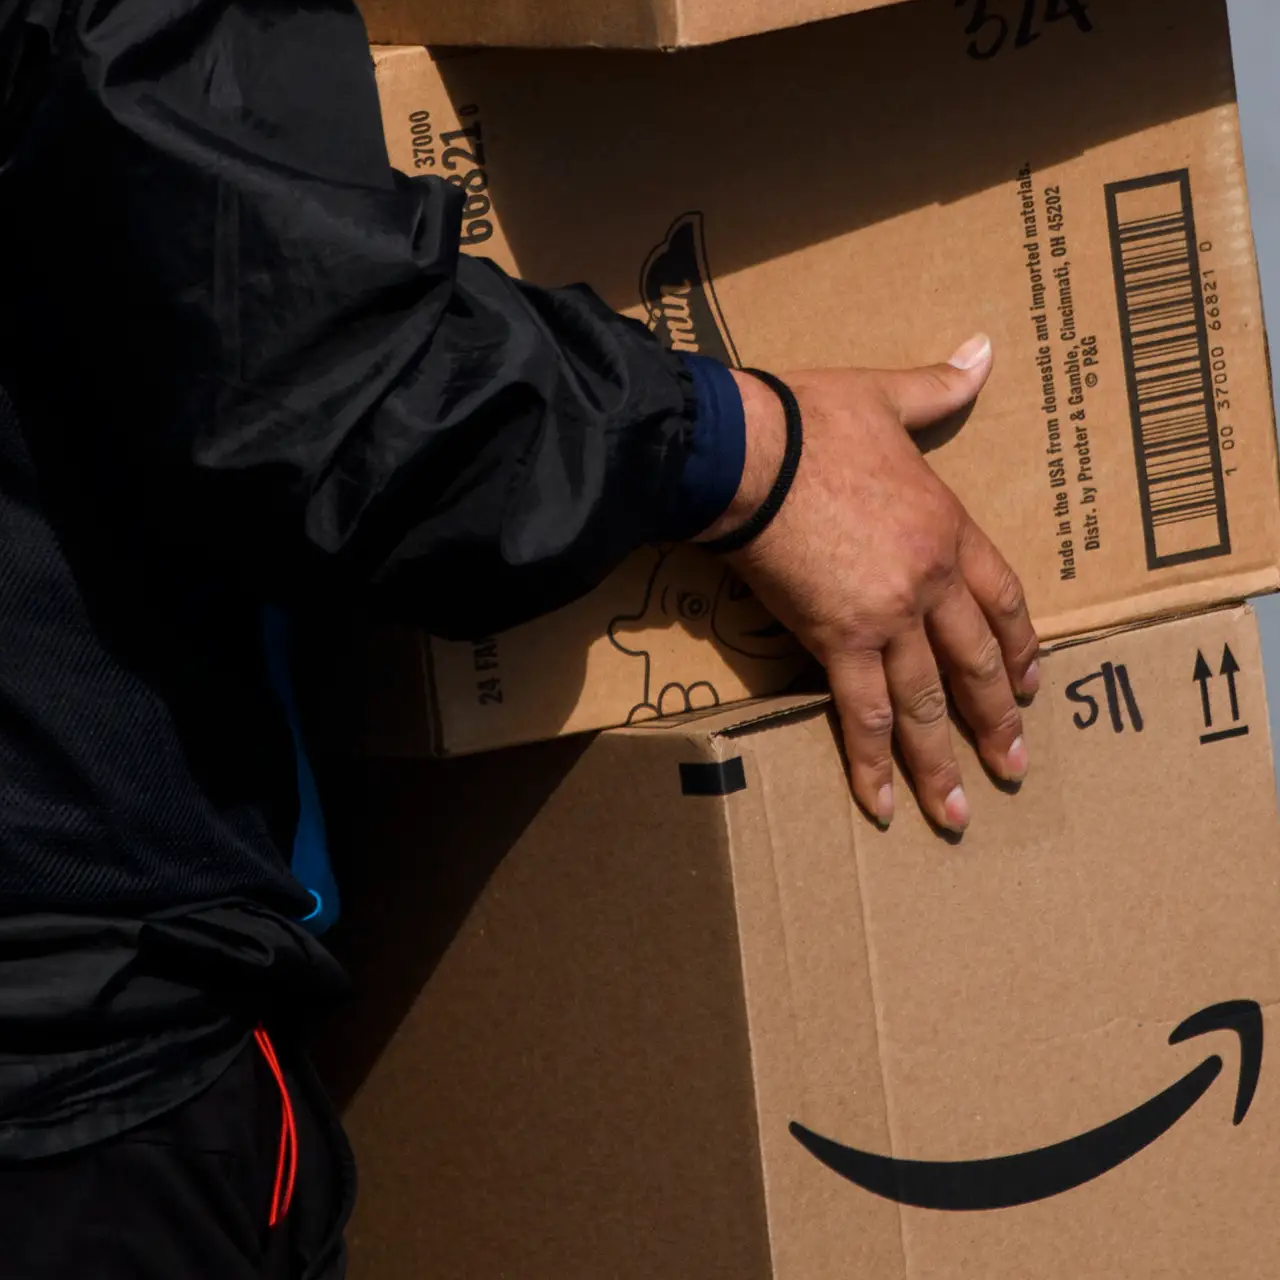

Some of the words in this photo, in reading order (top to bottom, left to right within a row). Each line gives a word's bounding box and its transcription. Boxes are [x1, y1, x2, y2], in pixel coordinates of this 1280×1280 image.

[408, 110, 435, 169] 37000
[1016, 161, 1038, 238] materials.
[1044, 185, 1064, 233] 45202
[1050, 235, 1067, 258] OH
[1199, 240, 1213, 253] 0
[1023, 242, 1046, 311] imported
[652, 279, 700, 353] min
[1053, 261, 1076, 342] Cincinnati,
[1202, 269, 1221, 331] 66821
[1031, 314, 1049, 342] and
[1080, 335, 1099, 367] P&G
[1035, 345, 1056, 413] domestic
[1064, 344, 1084, 406] Gamble,
[1211, 346, 1231, 412] 37000
[1069, 408, 1086, 422] &
[1046, 418, 1062, 455] from
[1074, 425, 1093, 483] Procter
[1220, 426, 1235, 451] 00
[1048, 457, 1066, 489] USA
[1225, 466, 1238, 476] 1
[1053, 492, 1069, 518] the
[1080, 487, 1097, 505] by
[1056, 520, 1072, 537] in
[1083, 508, 1100, 551] Distr.
[1058, 540, 1076, 581] Made
[472, 640, 499, 672] FA
[477, 676, 503, 705] 24
